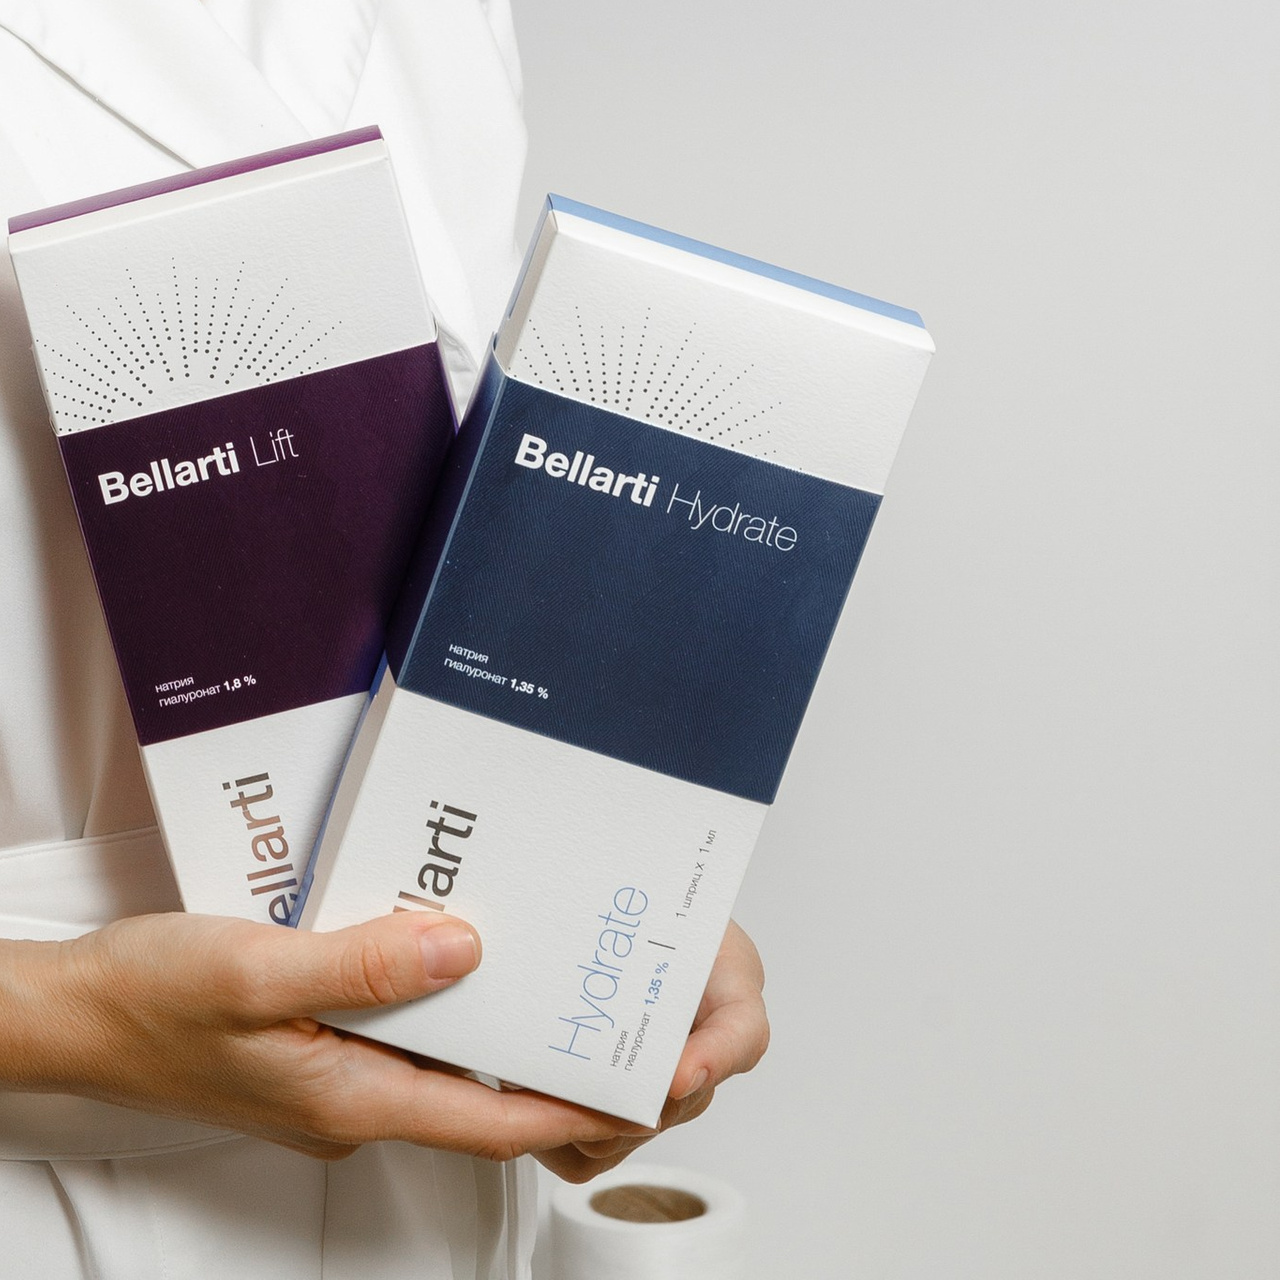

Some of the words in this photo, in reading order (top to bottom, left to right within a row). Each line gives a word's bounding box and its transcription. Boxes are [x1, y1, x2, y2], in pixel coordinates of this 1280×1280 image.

[97, 442, 240, 505] Bellarti
[251, 428, 299, 468] Lift
[514, 433, 660, 507] Bellarti
[667, 483, 799, 552] Hydrate
[155, 676, 195, 693] натрия
[159, 685, 221, 707] гиалуронат
[223, 678, 241, 692] 1,8
[243, 674, 257, 686] %
[443, 657, 508, 686] гиалуронат
[510, 678, 535, 695] 1,35
[537, 686, 549, 700] %
[448, 644, 489, 664] натрия
[222, 772, 298, 926] ellarti
[392, 800, 478, 912] larti
[682, 872, 705, 909] шприц
[705, 829, 717, 846] мл
[548, 885, 649, 1062] Hydrate
[610, 1030, 629, 1068] натрия
[624, 1012, 651, 1072] гиалуронат
[644, 977, 663, 1007] 1,35
